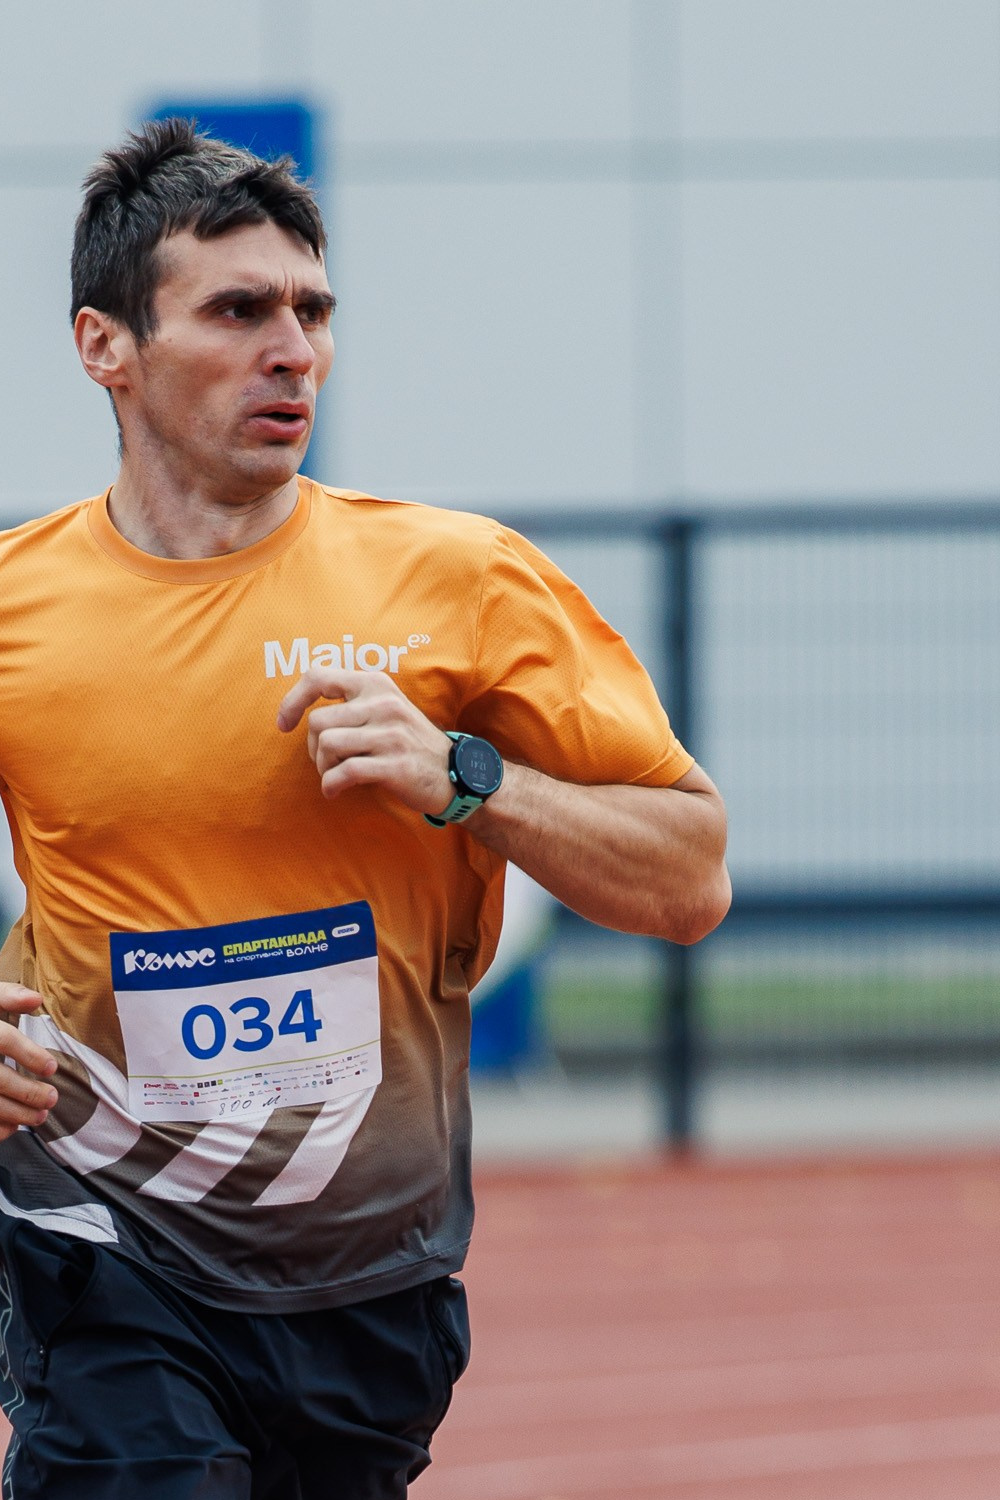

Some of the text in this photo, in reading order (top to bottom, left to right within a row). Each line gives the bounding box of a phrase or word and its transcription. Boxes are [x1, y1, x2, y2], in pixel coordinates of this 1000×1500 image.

[222, 929, 327, 956] СПАРТАКИАДА
[235, 949, 284, 962] спортивной
[181, 988, 323, 1060] 034
[219, 1099, 252, 1116] 800
